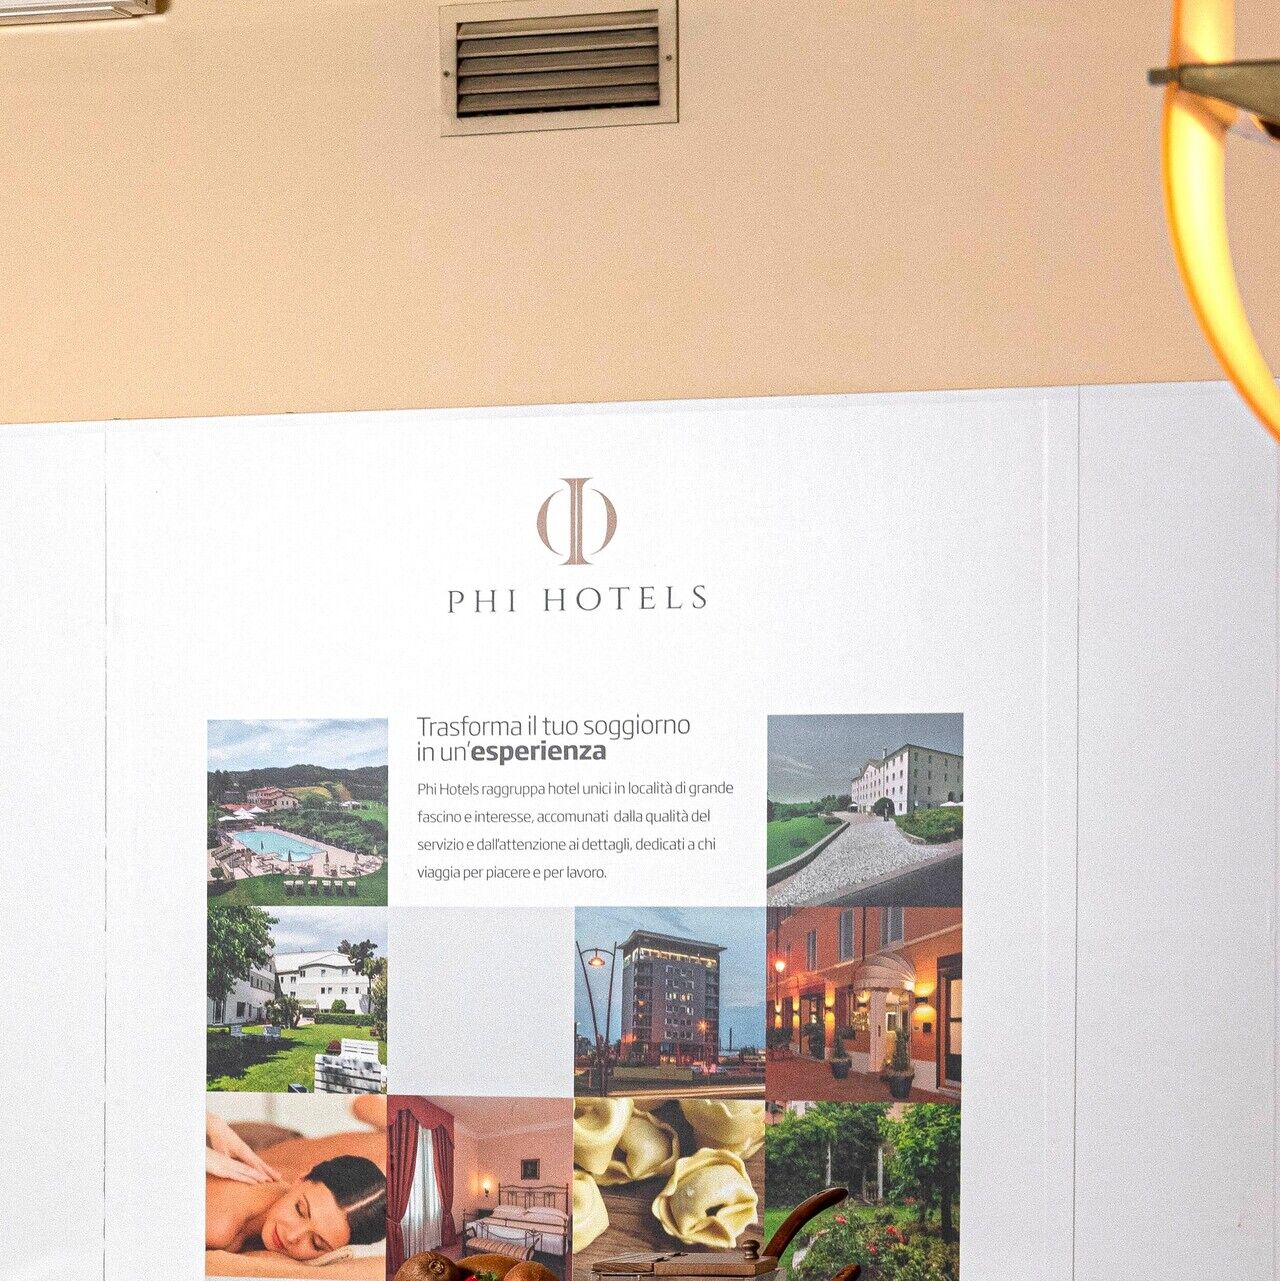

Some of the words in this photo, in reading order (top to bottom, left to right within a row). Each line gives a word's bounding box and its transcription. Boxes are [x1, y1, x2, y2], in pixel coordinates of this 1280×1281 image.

[447, 589, 517, 614] PHI
[543, 584, 708, 612] HOTELS
[417, 715, 523, 737] Trasforma
[527, 714, 537, 736] il
[543, 717, 579, 736] tuo
[583, 713, 691, 741] soggiorno
[417, 741, 435, 762] in
[440, 739, 607, 766] un'esperienza
[417, 782, 437, 796] Phi
[439, 782, 480, 796] Hotels
[481, 784, 546, 799] raggruppa
[547, 781, 580, 796] hotel
[582, 782, 612, 795] unici
[613, 782, 626, 795] in
[627, 780, 673, 795] località
[674, 781, 687, 794] di
[688, 781, 735, 797] grande
[417, 809, 462, 824] fascino
[463, 812, 472, 823] e
[474, 809, 535, 825] interesse,
[536, 809, 609, 823] accomunati
[613, 808, 643, 823] dalla
[645, 808, 689, 826] qualità
[690, 808, 711, 823] del
[417, 837, 464, 851] servizio
[466, 840, 474, 851] e
[476, 837, 567, 851] dall'attenzione
[568, 837, 579, 851] ai
[581, 836, 633, 854] dettagli,
[635, 837, 685, 851] dedicati
[687, 840, 695, 851] a
[697, 836, 716, 850] chi
[417, 866, 461, 882] viaggia
[462, 868, 484, 882] per
[485, 865, 531, 882] piacere
[532, 868, 541, 879] e
[543, 868, 564, 882] per
[566, 865, 607, 879] lavoro.
